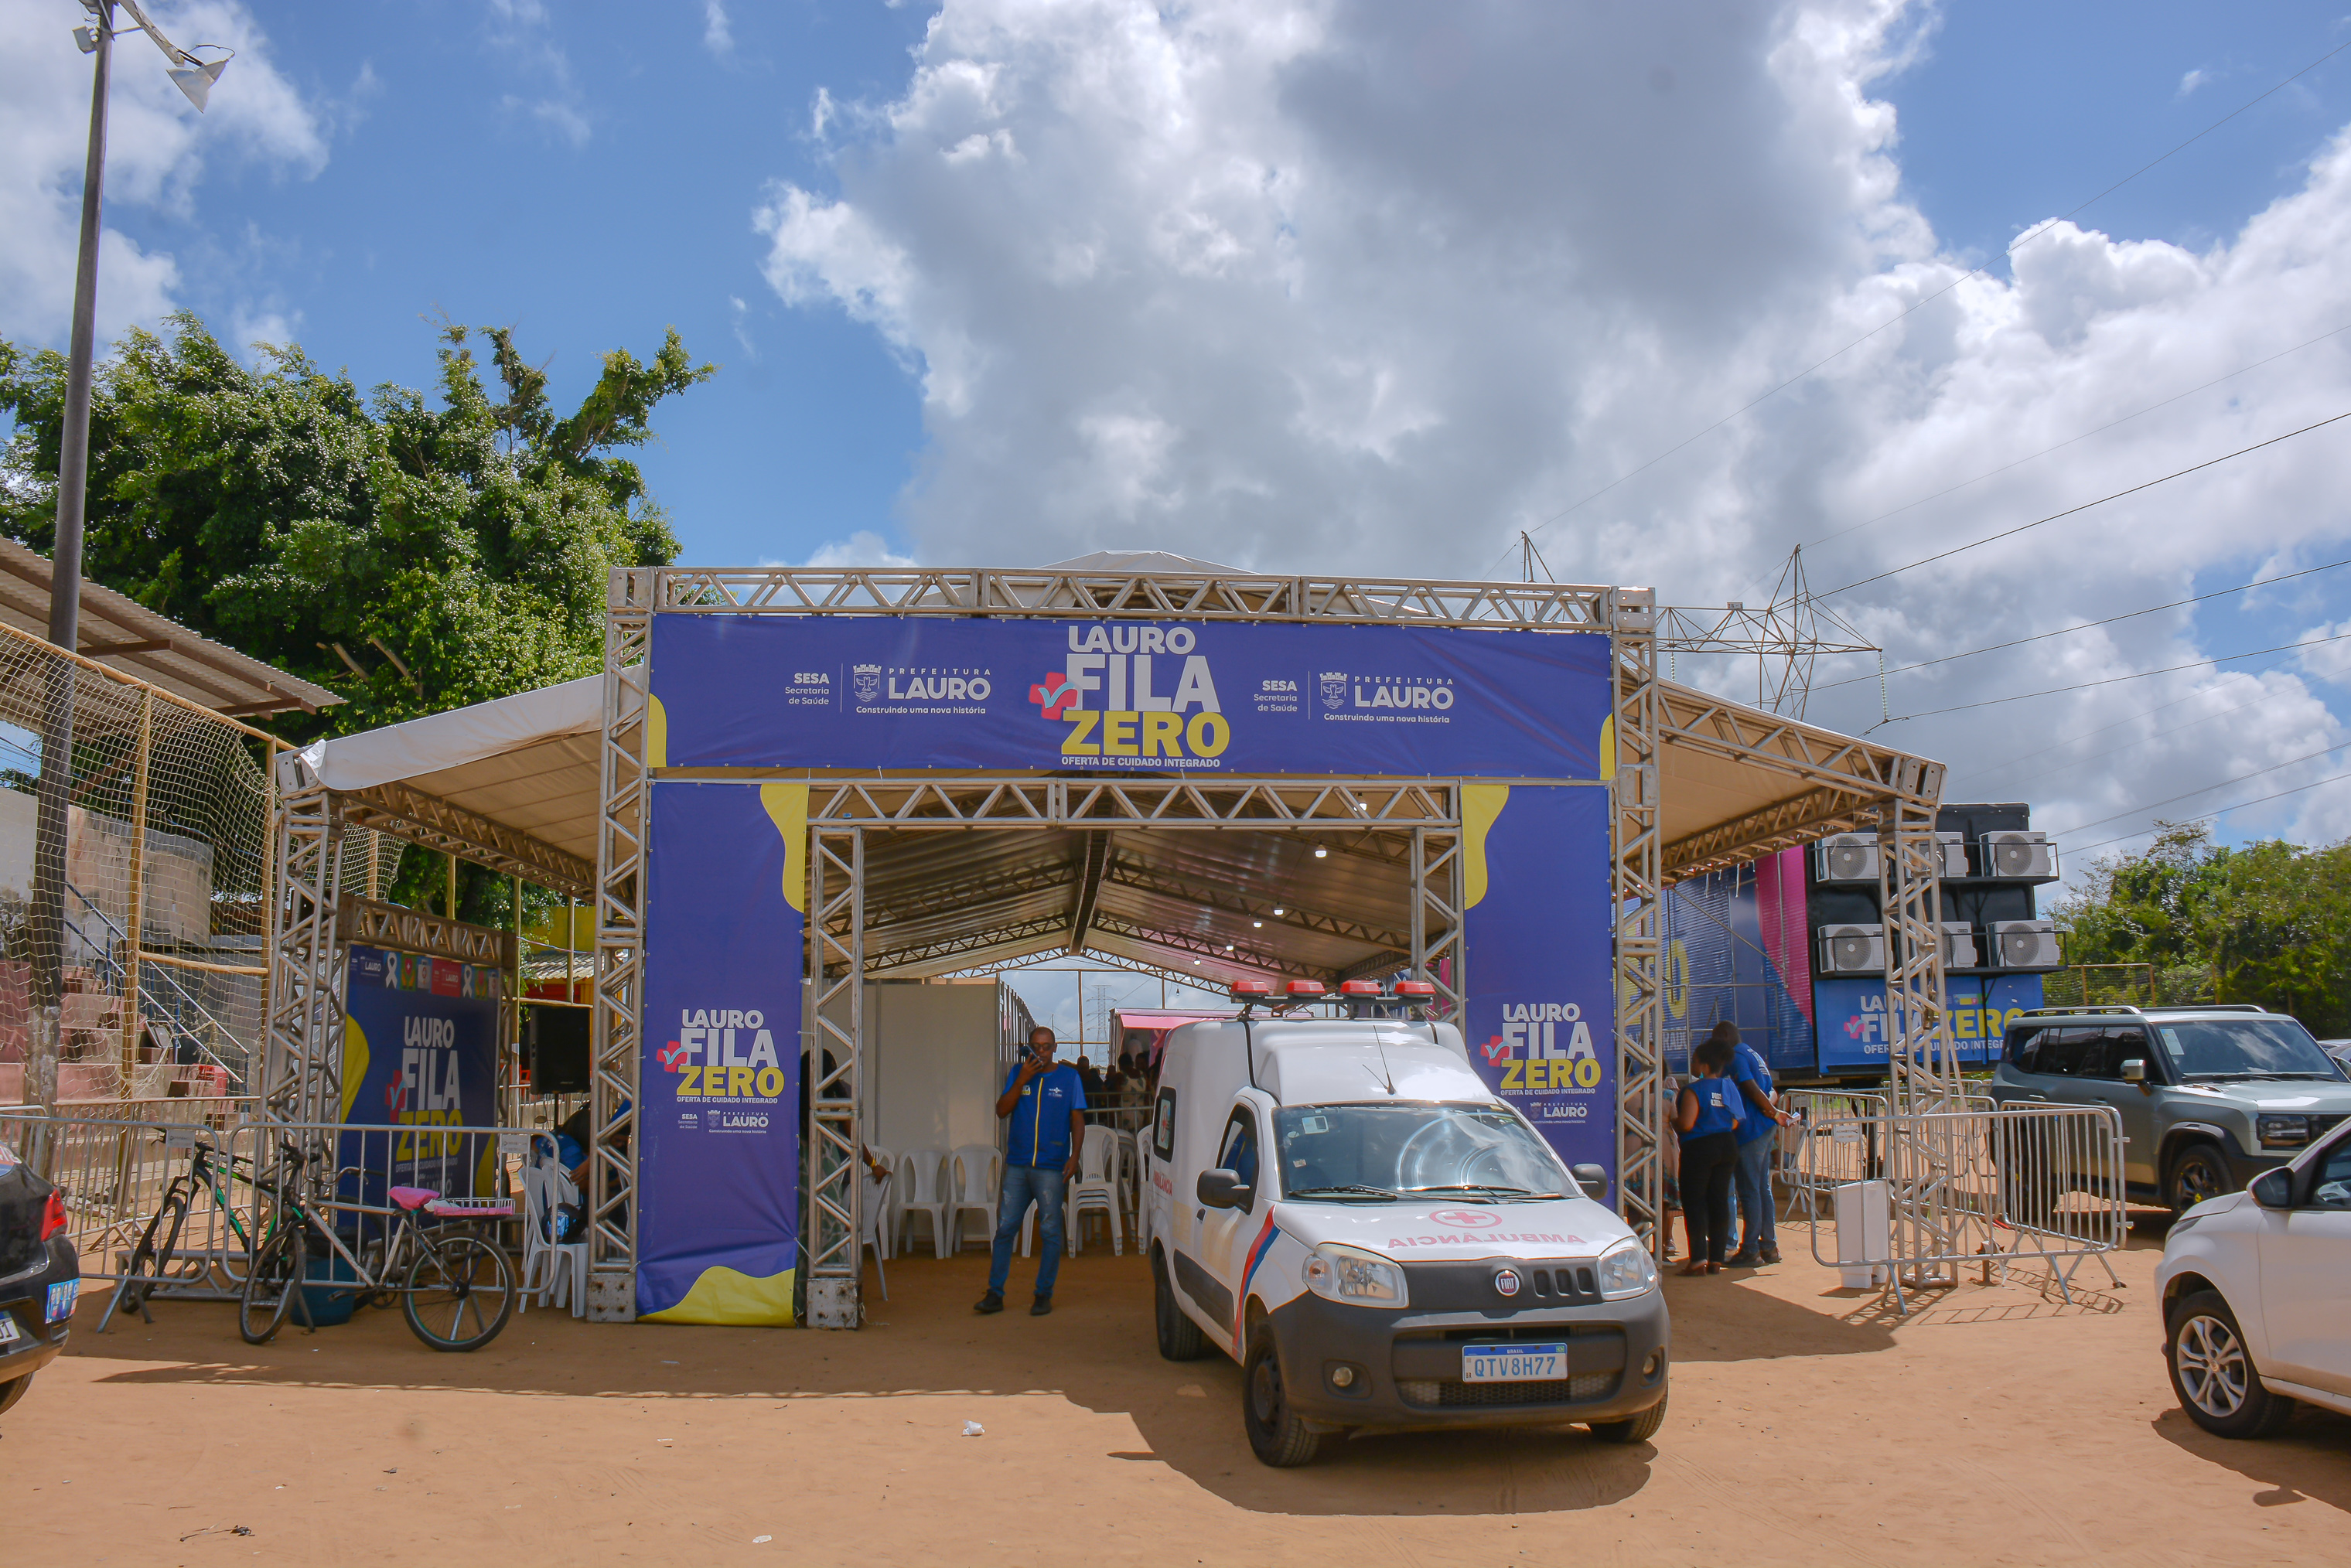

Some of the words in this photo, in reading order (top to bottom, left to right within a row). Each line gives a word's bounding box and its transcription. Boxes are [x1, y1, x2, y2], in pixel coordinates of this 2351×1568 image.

[1069, 625, 1196, 654] LAURO
[793, 673, 830, 684] SESA
[889, 677, 991, 700] LAURO
[1066, 653, 1221, 713] FILA
[1262, 680, 1297, 691] SESA
[1355, 676, 1453, 685] PREFEITURA
[802, 697, 829, 705] Saúde
[1254, 694, 1297, 702] Secretaria
[1271, 704, 1298, 712] Saúde
[1355, 685, 1454, 710] LAURO
[1324, 713, 1374, 721] Construindo
[1418, 714, 1450, 723] história
[1061, 711, 1230, 758] ZERO
[1061, 756, 1099, 765] OFERTA
[1102, 757, 1115, 765] DE
[1117, 757, 1161, 767] CUIDADO
[1164, 758, 1220, 768] INTEGRADO
[682, 1008, 764, 1029] LAURO
[1503, 1003, 1581, 1022] LAURO
[404, 1015, 455, 1048] LAURO
[1502, 1021, 1595, 1060] FILA
[681, 1028, 780, 1068] FILA
[401, 1048, 462, 1112] FILA
[677, 1065, 785, 1097] ZERO
[1500, 1058, 1602, 1089] ZERO
[723, 1116, 769, 1127] LAURO
[1544, 1106, 1588, 1118] LAURO
[395, 1109, 463, 1161] ZERO
[426, 1178, 452, 1195] LAUO
[1501, 1278, 1515, 1289] FIAT
[1474, 1356, 1556, 1377] QTV8H77
